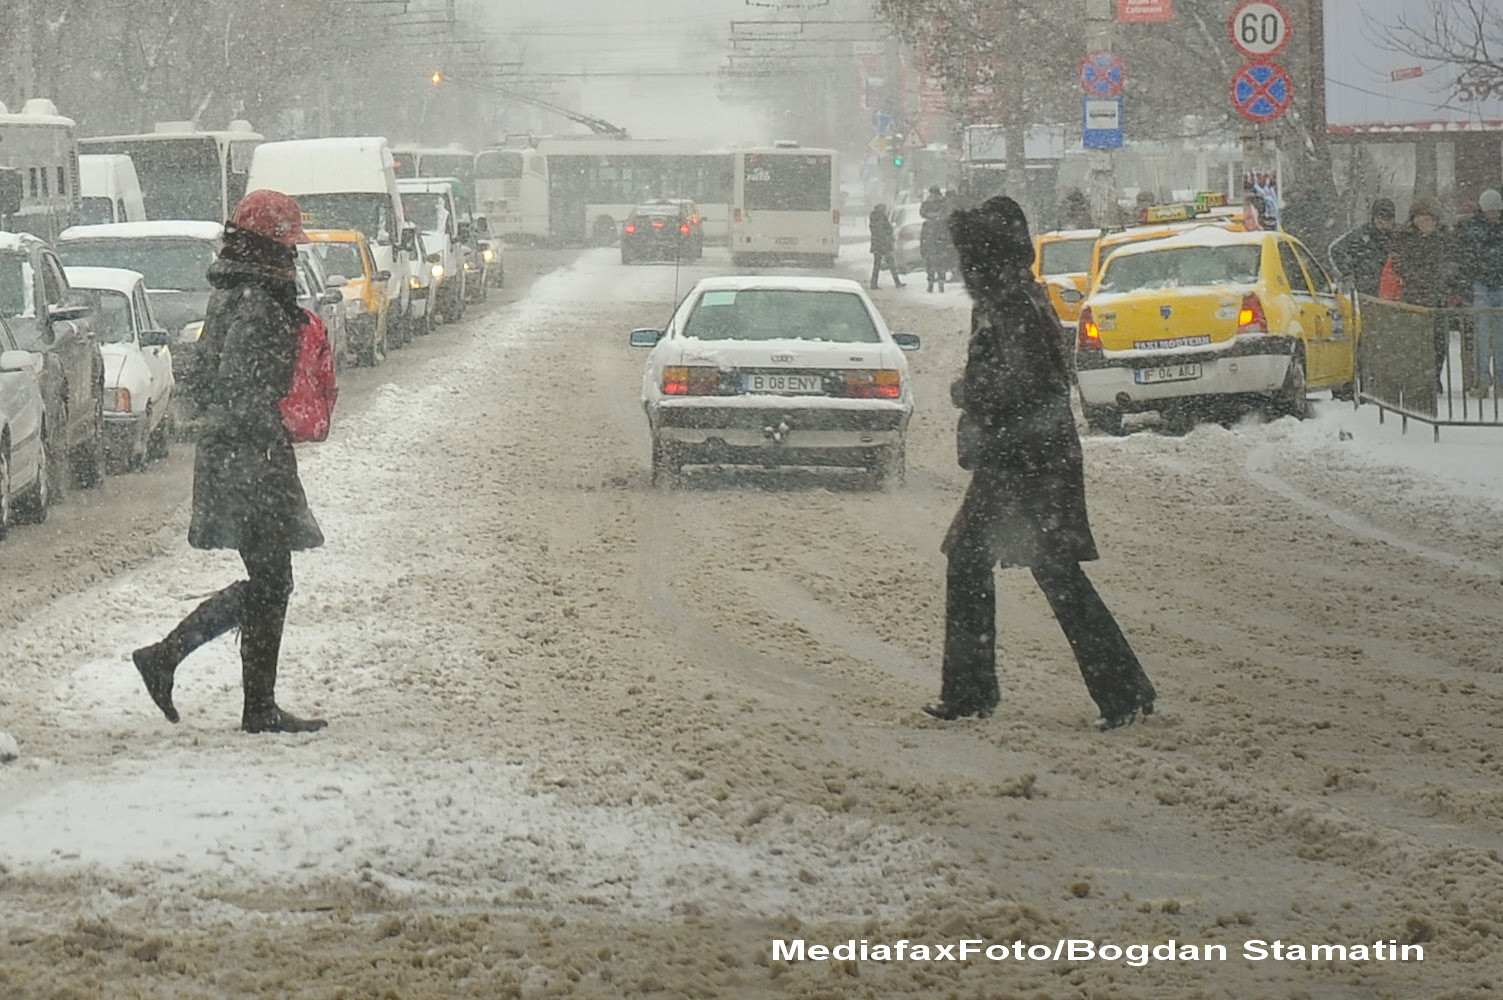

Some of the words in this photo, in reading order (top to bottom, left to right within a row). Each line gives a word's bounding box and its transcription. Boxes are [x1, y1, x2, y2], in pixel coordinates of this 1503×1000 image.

[1241, 12, 1278, 45] 60
[754, 376, 764, 389] B
[769, 376, 785, 389] 08
[788, 376, 818, 390] ENY
